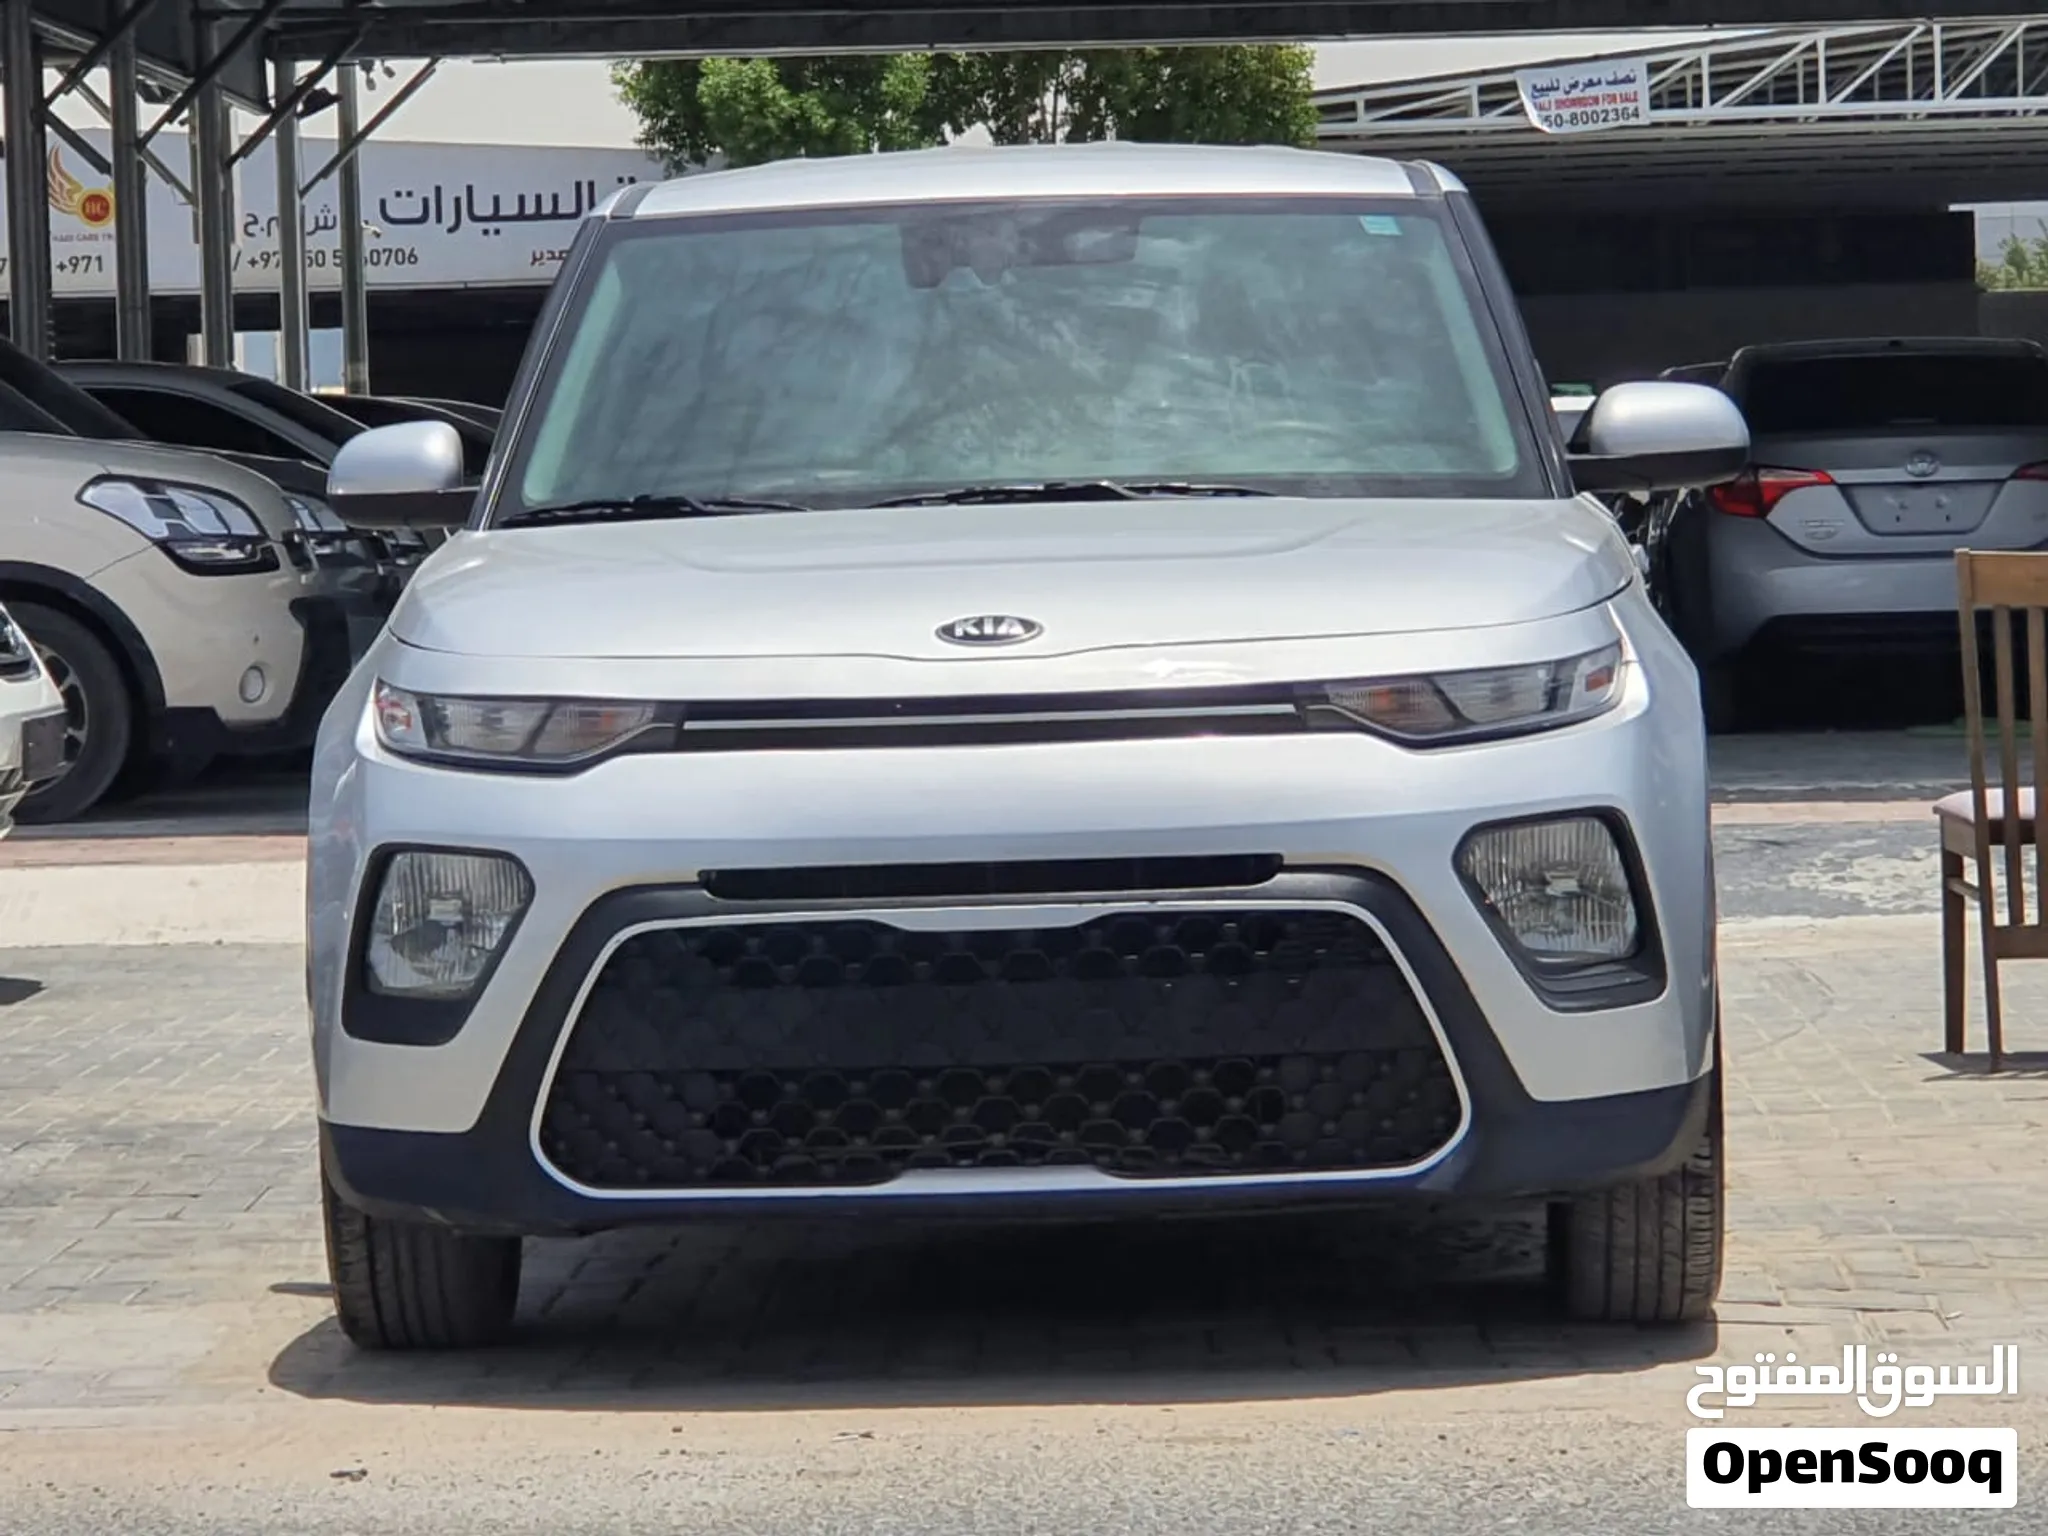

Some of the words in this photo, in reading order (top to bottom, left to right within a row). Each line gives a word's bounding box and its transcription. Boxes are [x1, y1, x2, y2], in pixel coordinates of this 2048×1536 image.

[1563, 75, 1602, 96] معرض
[1605, 69, 1637, 86] نصف
[1531, 78, 1560, 99] للبيع
[1601, 93, 1618, 107] FOR
[379, 179, 595, 236] السيارات
[953, 615, 1025, 638] KIA
